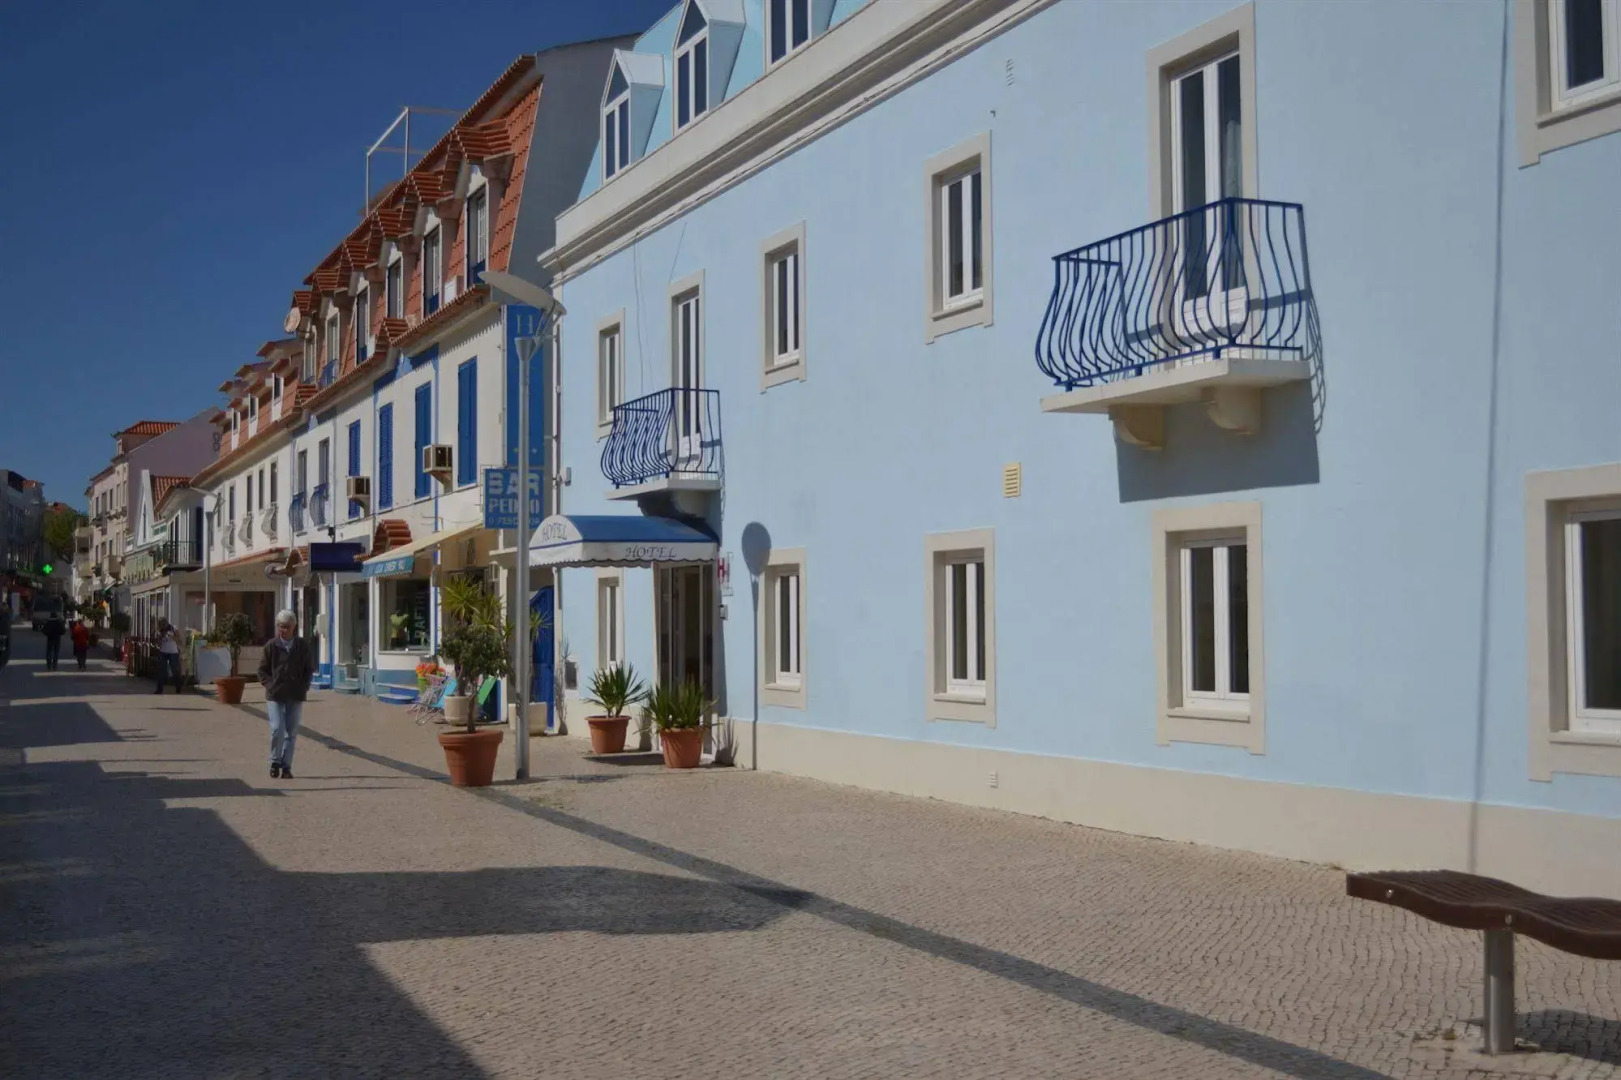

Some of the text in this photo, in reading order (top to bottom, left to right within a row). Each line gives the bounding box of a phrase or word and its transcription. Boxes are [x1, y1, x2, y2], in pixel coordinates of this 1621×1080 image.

[488, 472, 540, 495] BAR
[542, 522, 568, 541] HOTEL
[625, 545, 677, 559] HOTEL
